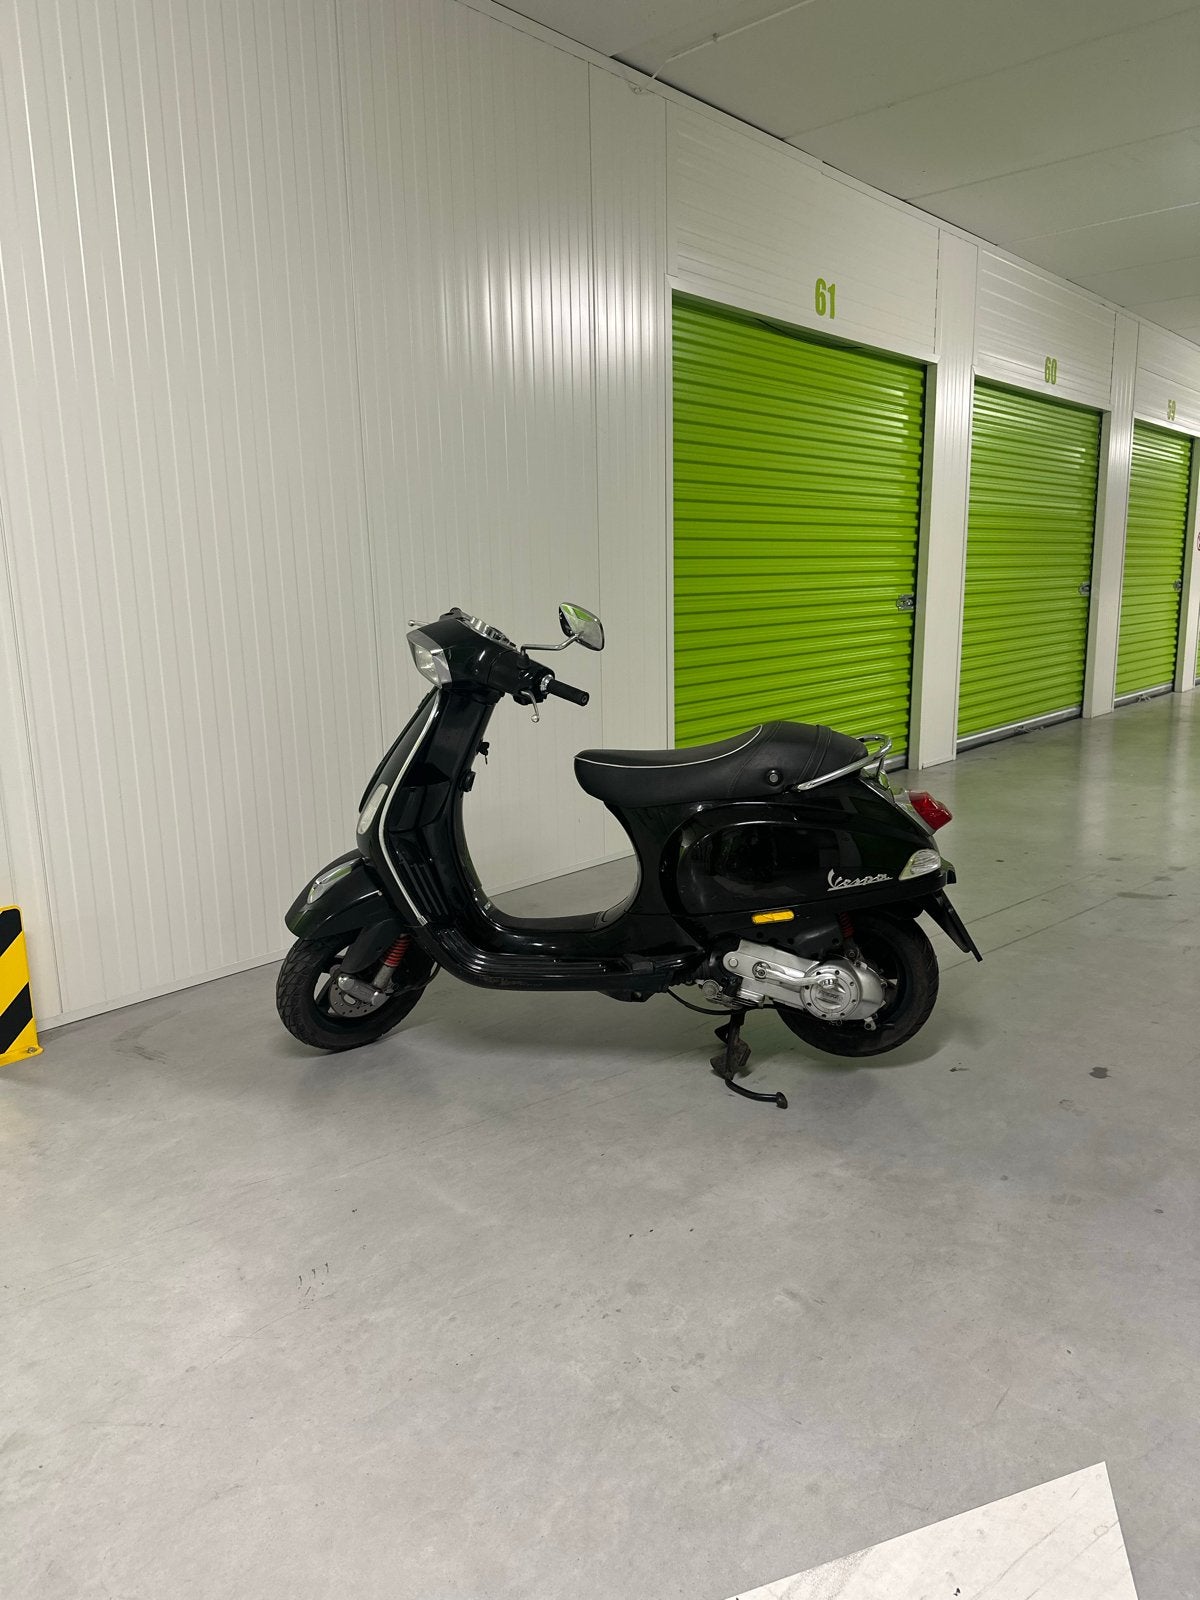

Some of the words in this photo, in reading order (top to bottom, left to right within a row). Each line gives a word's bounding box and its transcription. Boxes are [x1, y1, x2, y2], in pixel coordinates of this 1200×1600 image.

[815, 278, 836, 320] 61
[1044, 356, 1057, 385] 60
[827, 868, 893, 892] Vespa
